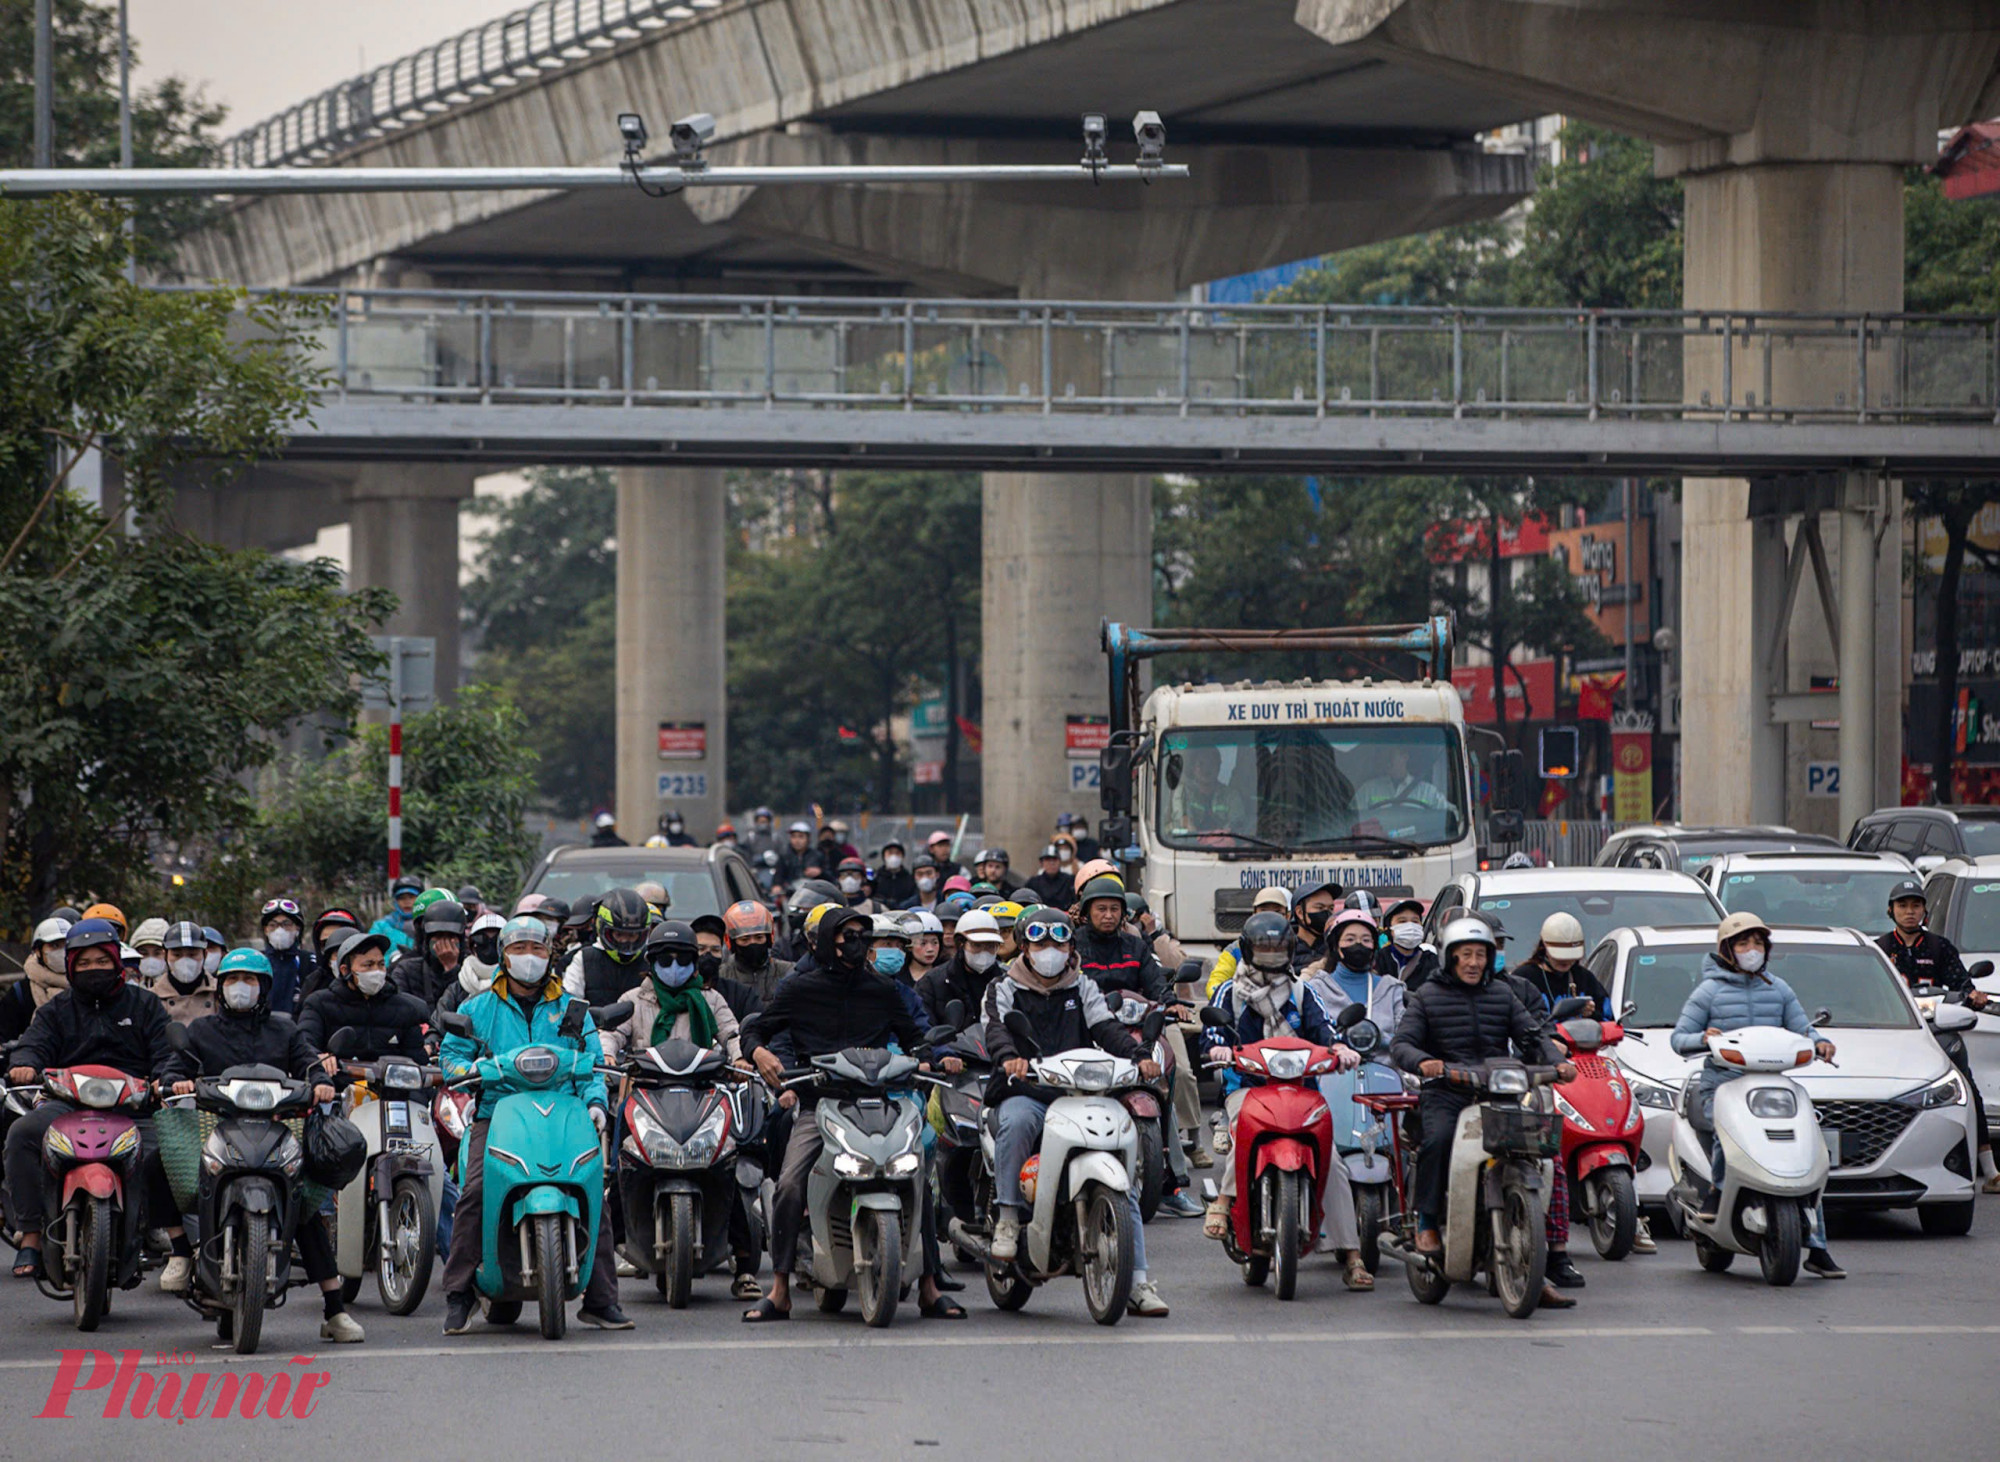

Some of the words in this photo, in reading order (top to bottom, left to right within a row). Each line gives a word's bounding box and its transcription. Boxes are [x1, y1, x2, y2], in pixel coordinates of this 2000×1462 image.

[1581, 534, 1614, 583] Wang
[1228, 704, 1246, 720] XE
[1252, 703, 1279, 720] DUY
[1285, 699, 1308, 719] TRÌ
[1314, 697, 1360, 719] THOÁT
[1365, 696, 1404, 718] NƯỚC
[1240, 867, 1266, 888] CÔNG
